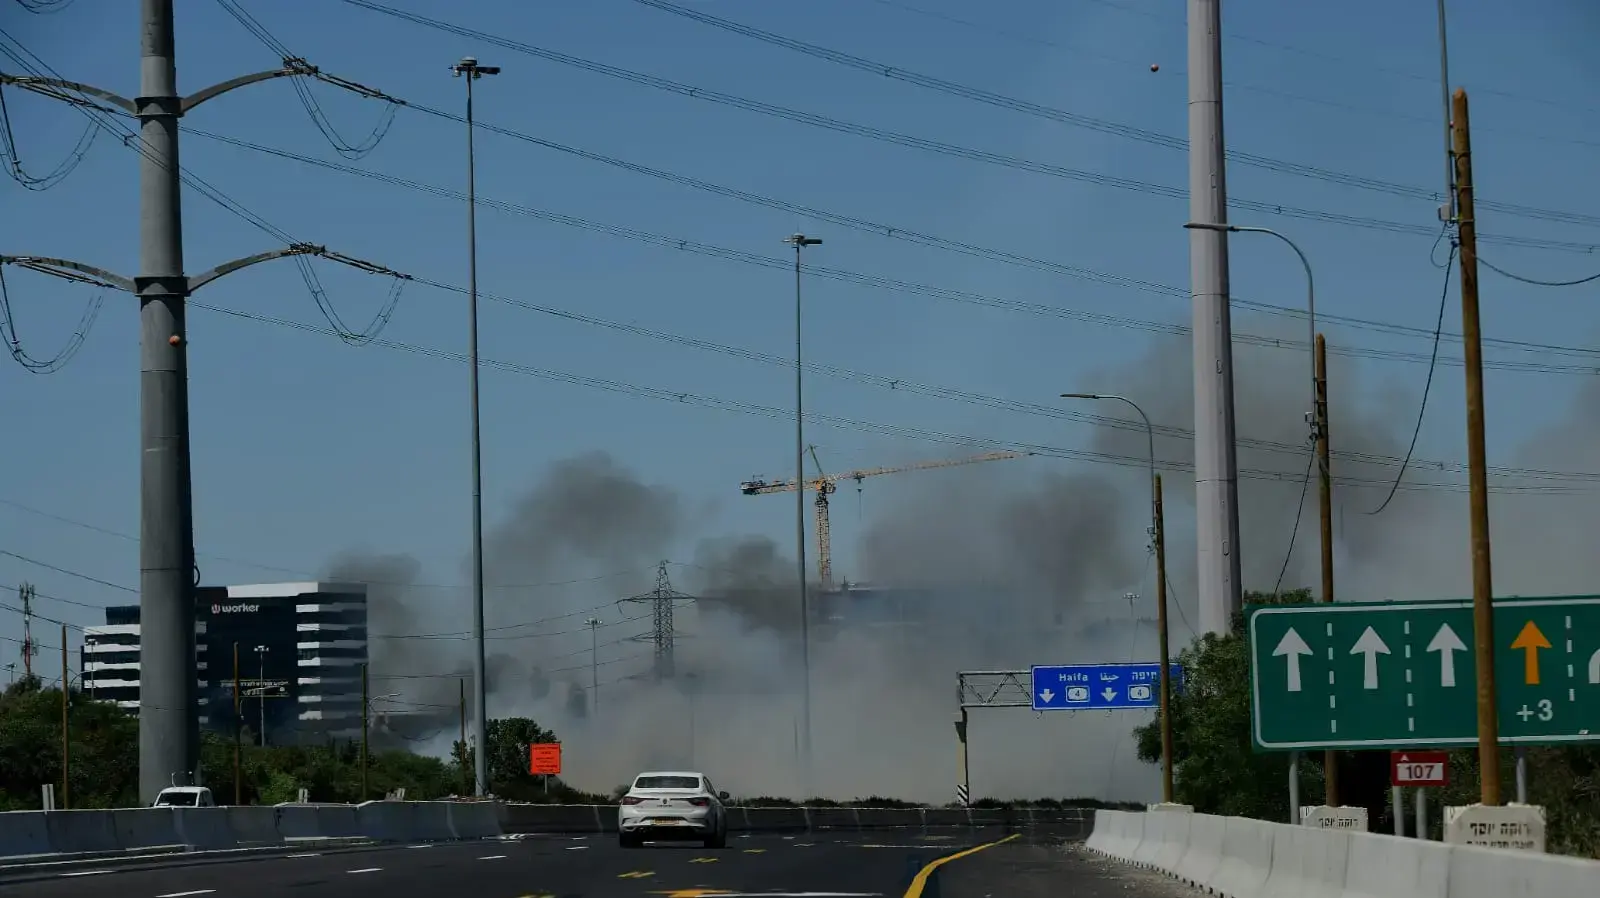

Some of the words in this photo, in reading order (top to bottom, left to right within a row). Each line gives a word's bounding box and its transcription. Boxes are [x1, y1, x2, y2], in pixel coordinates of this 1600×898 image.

[221, 603, 260, 613] worker
[1059, 673, 1089, 682] Haifa
[1100, 673, 1120, 683] حيفا
[1131, 671, 1157, 680] חיפה
[1516, 699, 1553, 721] +3
[1406, 765, 1435, 779] 107
